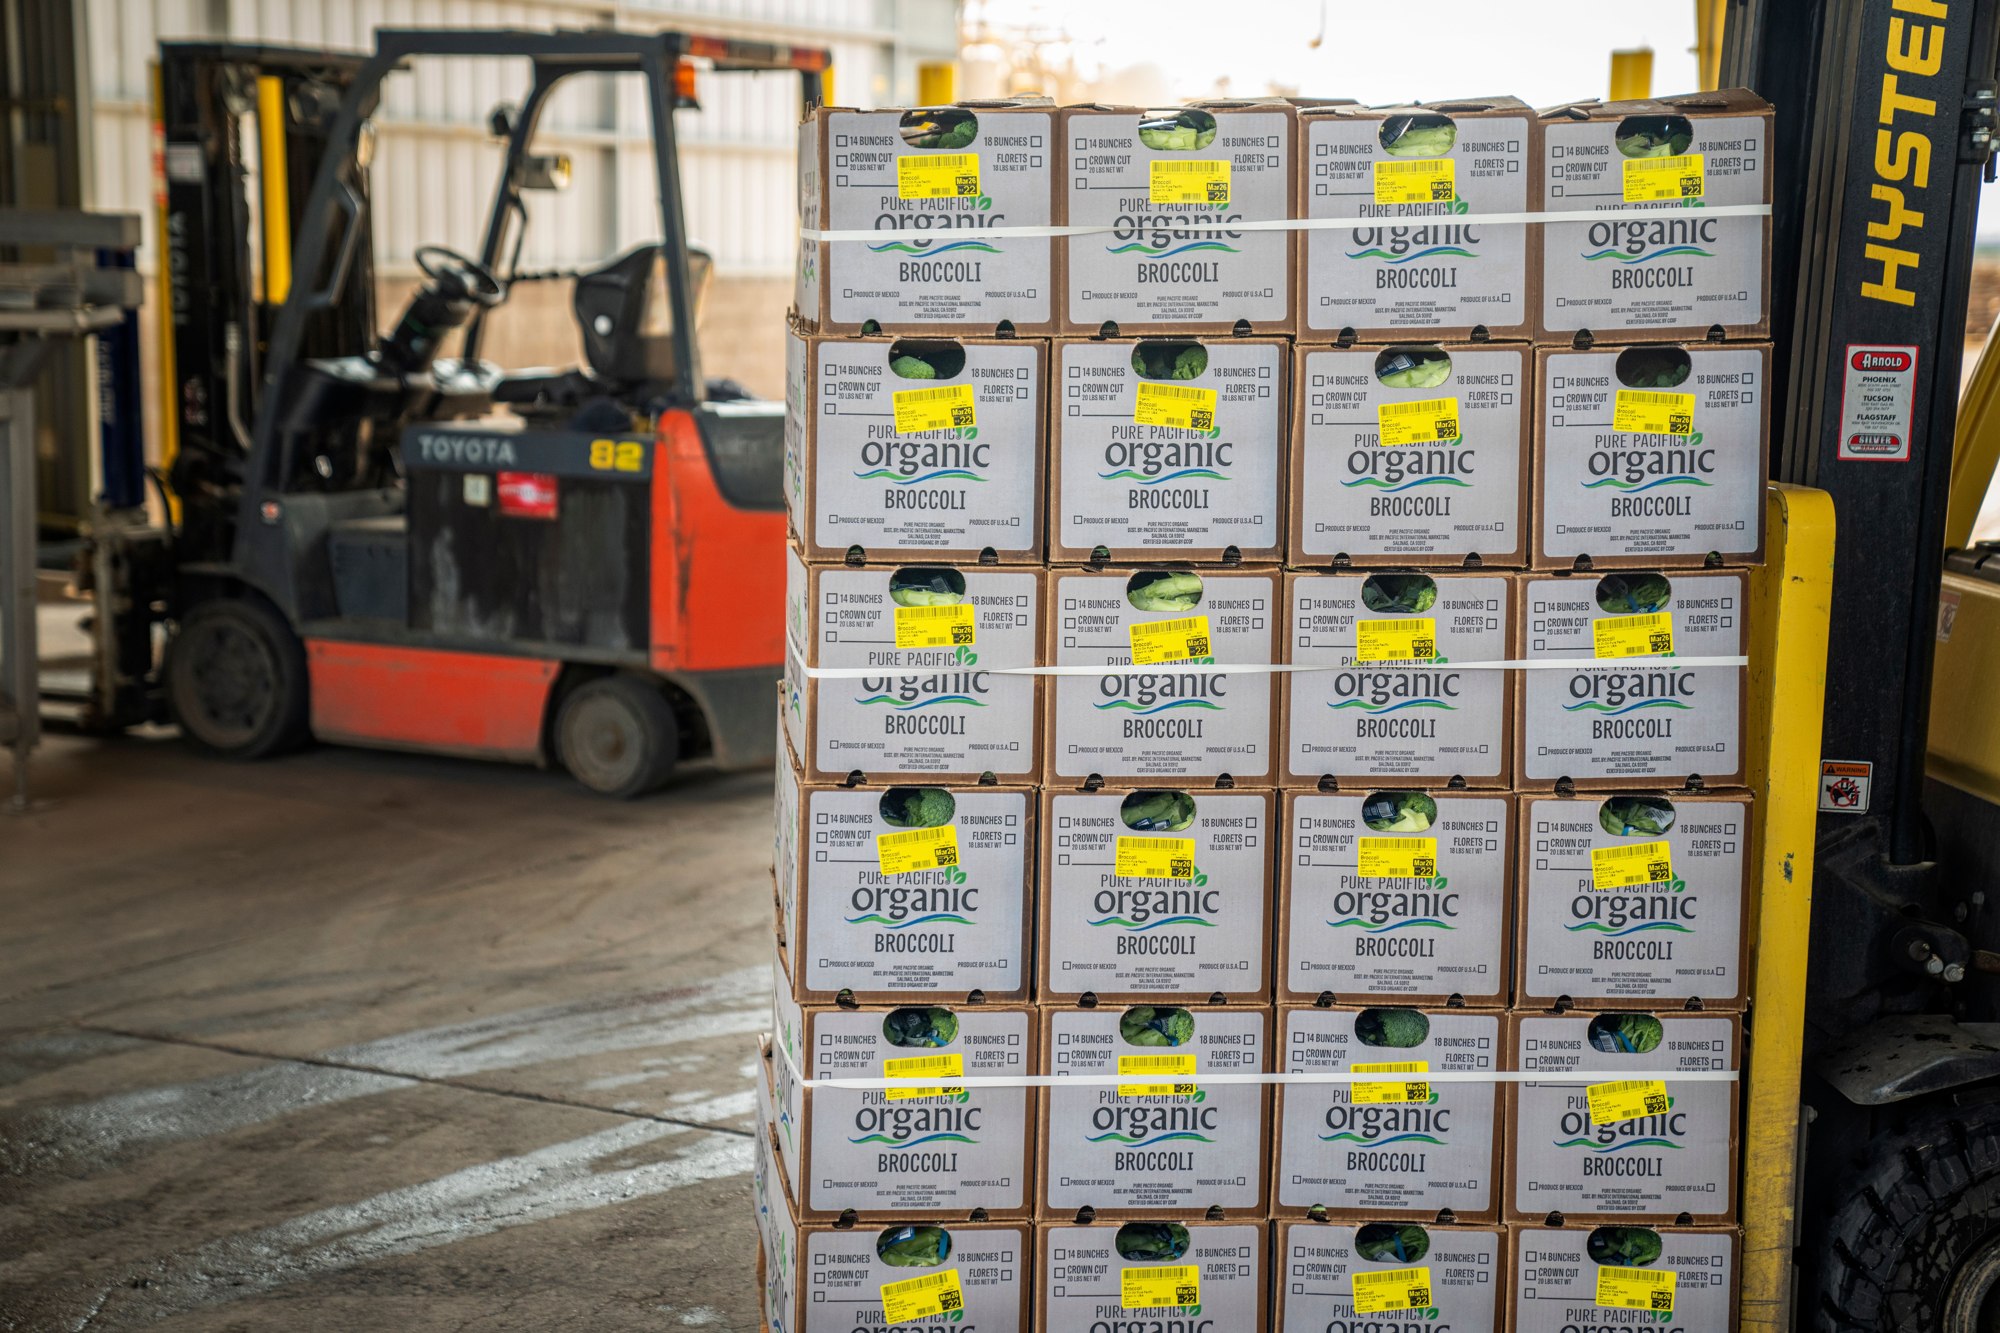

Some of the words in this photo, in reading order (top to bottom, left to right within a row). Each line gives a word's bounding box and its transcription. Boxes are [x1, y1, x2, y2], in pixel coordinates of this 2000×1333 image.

[850, 136, 858, 145] 14
[859, 136, 893, 146] BUNCHES
[1330, 145, 1338, 154] 14
[1339, 144, 1373, 154] BUNCHES
[997, 153, 1027, 163] FLORETS
[1089, 155, 1116, 165] CROWN
[1117, 155, 1131, 164] CUT
[1474, 158, 1504, 168] FLORETS
[1566, 162, 1593, 172] CROWN
[1594, 162, 1608, 171] CUT
[881, 196, 914, 210] PURE
[1120, 198, 1152, 212] PURE
[1359, 204, 1392, 218] PURE
[874, 214, 1005, 248] organic
[1113, 214, 1242, 249] organic
[1588, 218, 1717, 256] organic
[1352, 222, 1481, 255] organic
[899, 262, 981, 282] BROCCOLI
[1138, 262, 1218, 283] BROCCOLI
[1376, 268, 1456, 289] BROCCOLI
[1612, 267, 1693, 289] BROCCOLI
[971, 368, 980, 377] 18
[981, 368, 1014, 378] BUNCHES
[1083, 368, 1090, 376] 14
[1092, 367, 1125, 377] BUNCHES
[1457, 375, 1465, 384] 18
[1467, 375, 1499, 384] BUNCHES
[1567, 378, 1575, 387] 14
[1576, 377, 1609, 387] BUNCHES
[1226, 384, 1256, 393] FLORETS
[1709, 390, 1739, 400] FLORETS
[1856, 413, 1897, 421] FLAGSTAFF
[1112, 426, 1144, 439] PURE
[1595, 434, 1627, 448] PURE
[418, 435, 517, 465] TOYOTA
[589, 439, 644, 472] 82
[861, 441, 990, 477] organic
[1105, 442, 1232, 475] organic
[1347, 450, 1475, 483] organic
[1588, 449, 1715, 484] organic
[885, 489, 966, 510] BROCCOLI
[1129, 489, 1209, 509] BROCCOLI
[1371, 497, 1450, 516] BROCCOLI
[1611, 496, 1691, 517] BROCCOLI
[840, 594, 848, 603] 14
[849, 594, 883, 604] BUNCHES
[1313, 600, 1321, 608] 14
[1323, 600, 1355, 609] BUNCHES
[983, 612, 1013, 621] FLORETS
[1078, 616, 1105, 624] CROWN
[1106, 616, 1119, 624] CUT
[1454, 616, 1484, 625] FLORETS
[1547, 618, 1574, 627] CROWN
[1575, 617, 1588, 626] CUT
[869, 652, 901, 666] PURE
[862, 670, 989, 702] organic
[1100, 673, 1226, 705] organic
[1334, 673, 1460, 705] organic
[1569, 672, 1695, 707] organic
[885, 715, 965, 735] BROCCOLI
[1123, 719, 1202, 738] BROCCOLI
[1357, 719, 1436, 738] BROCCOLI
[1593, 719, 1672, 739] BROCCOLI
[1836, 766, 1867, 774] WARNING
[961, 816, 969, 824] 18
[970, 816, 1002, 825] BUNCHES
[1073, 818, 1080, 826] 14
[1082, 818, 1114, 827] BUNCHES
[1442, 821, 1450, 830] 18
[1452, 822, 1483, 831] BUNCHES
[1551, 823, 1559, 832] 14
[1560, 823, 1593, 832] BUNCHES
[1213, 834, 1243, 843] FLORETS
[1692, 840, 1721, 849] FLORETS
[859, 871, 891, 885] PURE
[1101, 874, 1133, 887] PURE
[1341, 876, 1373, 889] PURE
[851, 887, 978, 920] organic
[1094, 890, 1219, 922] organic
[1333, 891, 1459, 925] organic
[1571, 895, 1697, 928] organic
[874, 934, 954, 953] BROCCOLI
[1117, 936, 1196, 955] BROCCOLI
[1356, 937, 1434, 957] BROCCOLI
[1593, 941, 1672, 960] BROCCOLI
[834, 1035, 842, 1044] 14
[844, 1035, 876, 1044] BUNCHES
[1307, 1033, 1315, 1042] 14
[1316, 1033, 1348, 1043] BUNCHES
[975, 1051, 1005, 1060] FLORETS
[1071, 1050, 1098, 1059] CROWN
[1098, 1050, 1112, 1059] CUT
[1445, 1053, 1475, 1063] FLORETS
[1539, 1056, 1565, 1064] CROWN
[1566, 1056, 1580, 1065] CUT
[1100, 1091, 1131, 1104] PURE
[855, 1107, 981, 1140] organic
[1092, 1107, 1217, 1138] organic
[1325, 1106, 1450, 1141] organic
[878, 1153, 957, 1172] BROCCOLI
[1115, 1152, 1193, 1171] BROCCOLI
[1347, 1152, 1425, 1172] BROCCOLI
[1583, 1157, 1662, 1176] BROCCOLI
[957, 1253, 965, 1262] 18
[967, 1253, 998, 1262] BUNCHES
[1068, 1250, 1075, 1258] 14
[1077, 1249, 1109, 1259] BUNCHES
[1434, 1253, 1442, 1261] 18
[1444, 1253, 1475, 1263] BUNCHES
[1539, 1252, 1547, 1261] 14
[1548, 1252, 1581, 1262] BUNCHES
[1207, 1263, 1236, 1272] FLORETS
[1679, 1271, 1708, 1281] FLORETS
[1096, 1305, 1127, 1318] PURE
[1566, 1309, 1598, 1322] PURE
